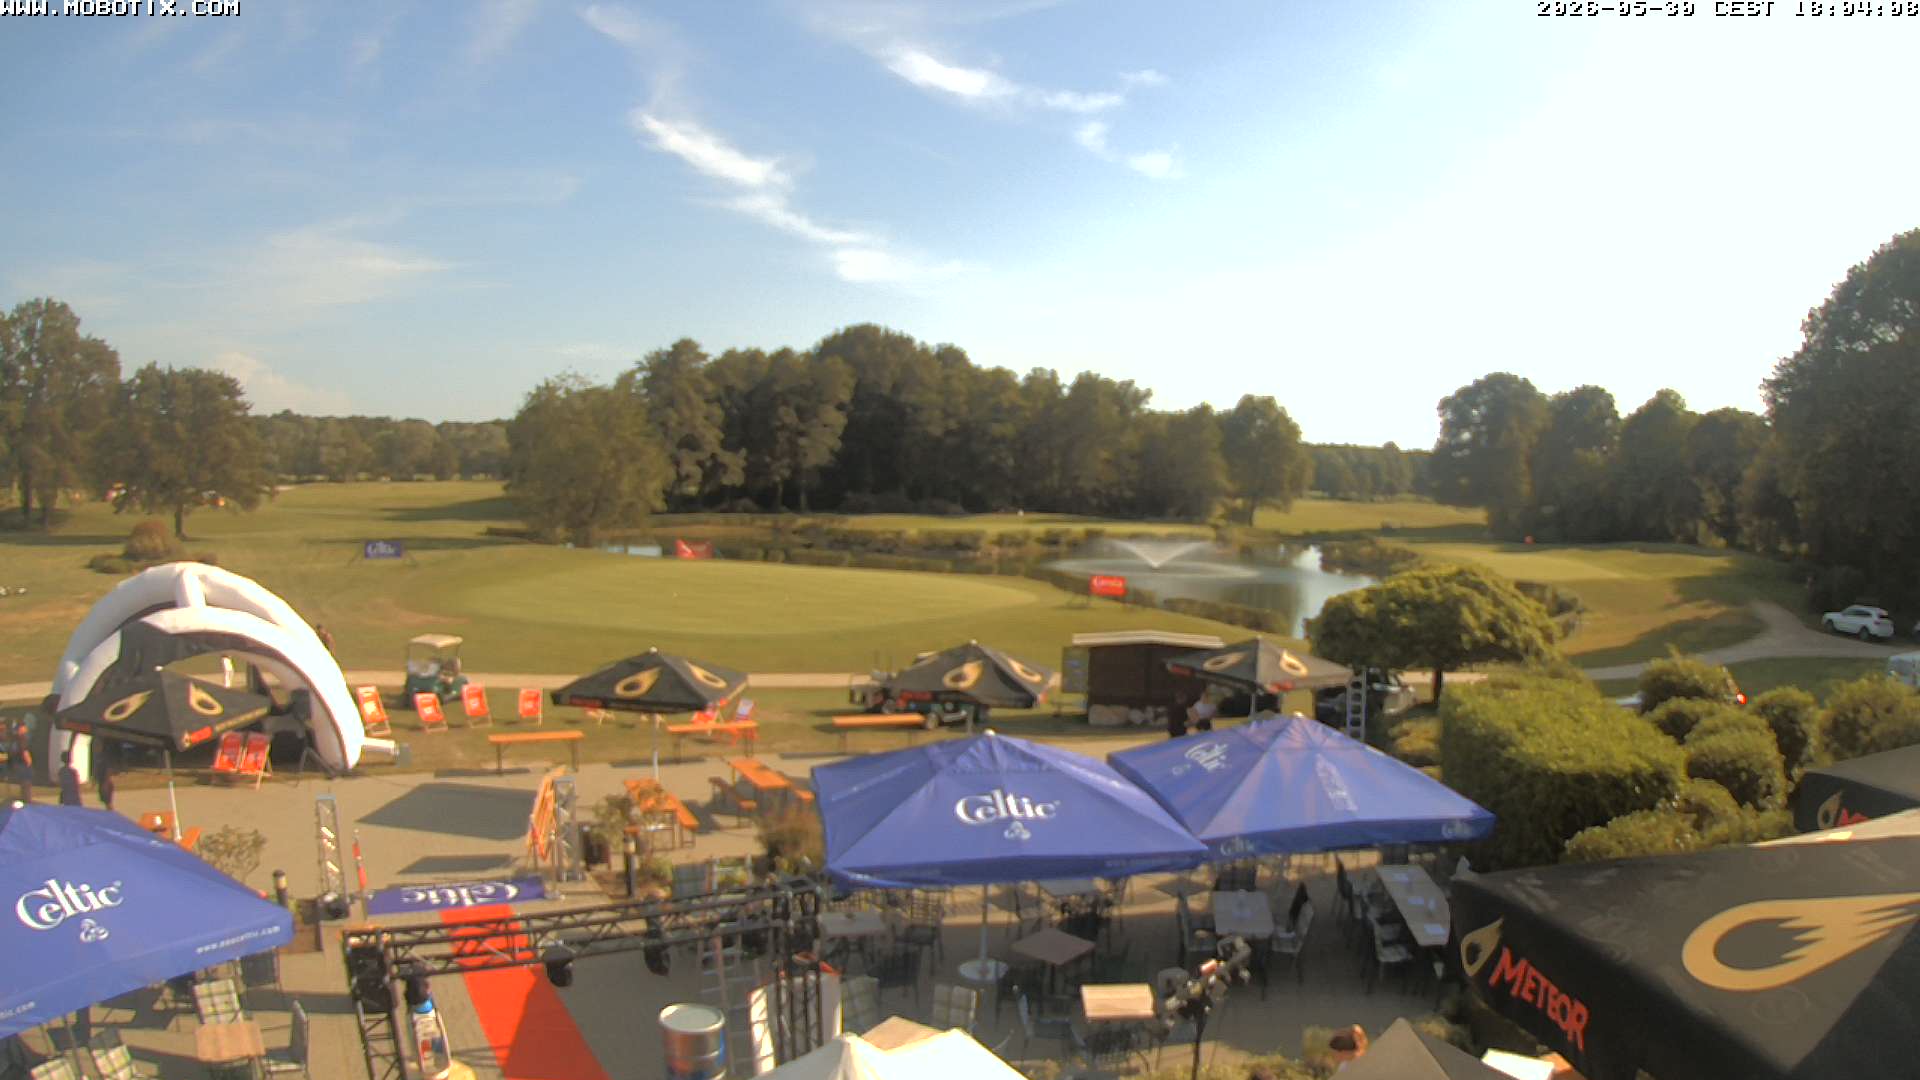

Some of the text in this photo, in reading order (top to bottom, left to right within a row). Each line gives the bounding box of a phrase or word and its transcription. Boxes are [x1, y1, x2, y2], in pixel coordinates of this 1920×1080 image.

[954, 788, 1058, 825] Celtic
[15, 878, 124, 931] Celtic
[1487, 945, 1590, 1052] METEOR
